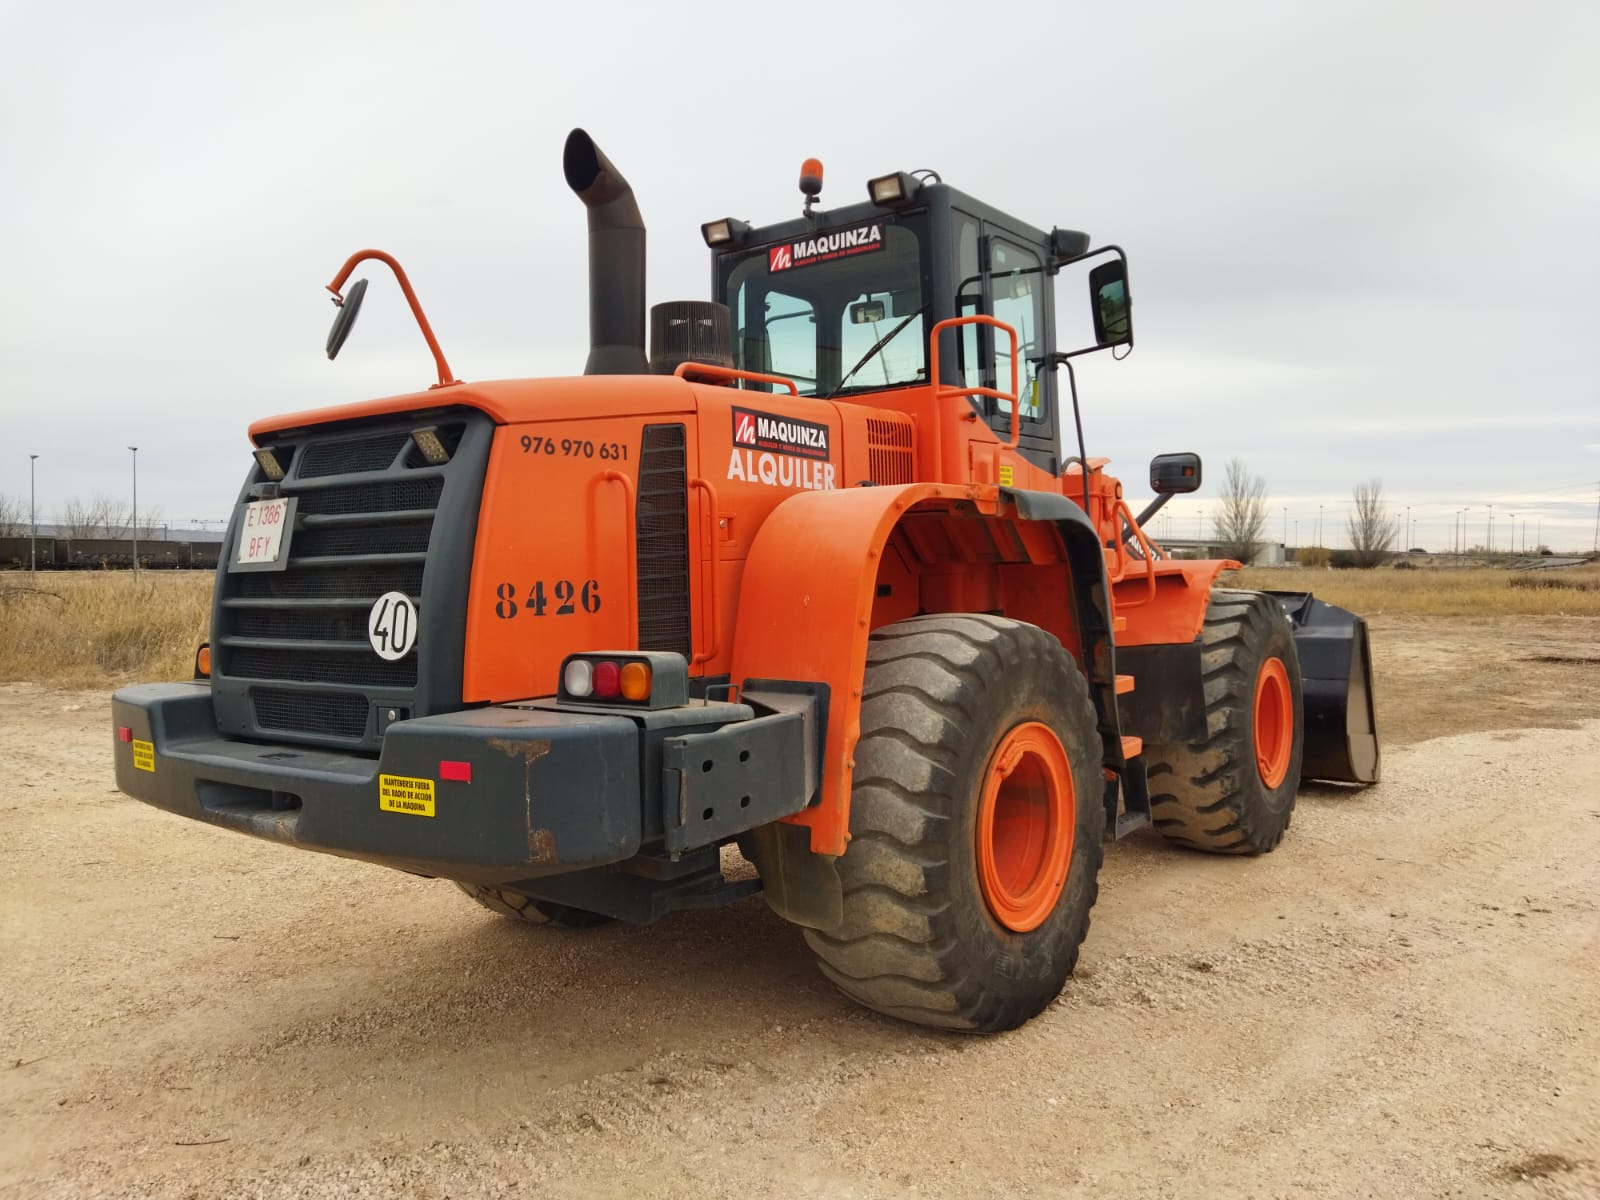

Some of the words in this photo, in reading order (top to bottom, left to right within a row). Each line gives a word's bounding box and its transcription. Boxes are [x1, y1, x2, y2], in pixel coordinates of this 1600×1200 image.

[793, 224, 881, 260] MAQUINZA
[757, 417, 827, 449] MAQUINZA
[520, 435, 556, 456] 976
[561, 438, 594, 459] 970
[599, 442, 628, 461] 631
[727, 448, 836, 491] ALQUILER
[248, 508, 256, 527] E
[257, 504, 281, 526] 1386
[248, 536, 271, 557] BFY
[495, 579, 602, 620] 8426
[373, 598, 409, 654] 40
[382, 788, 390, 796] DEL
[391, 789, 406, 798] RADIO
[407, 791, 413, 800] DE
[383, 778, 414, 788] MANTENERSE
[414, 781, 430, 790] FUERA
[389, 800, 395, 808] DE
[396, 801, 402, 809] LA
